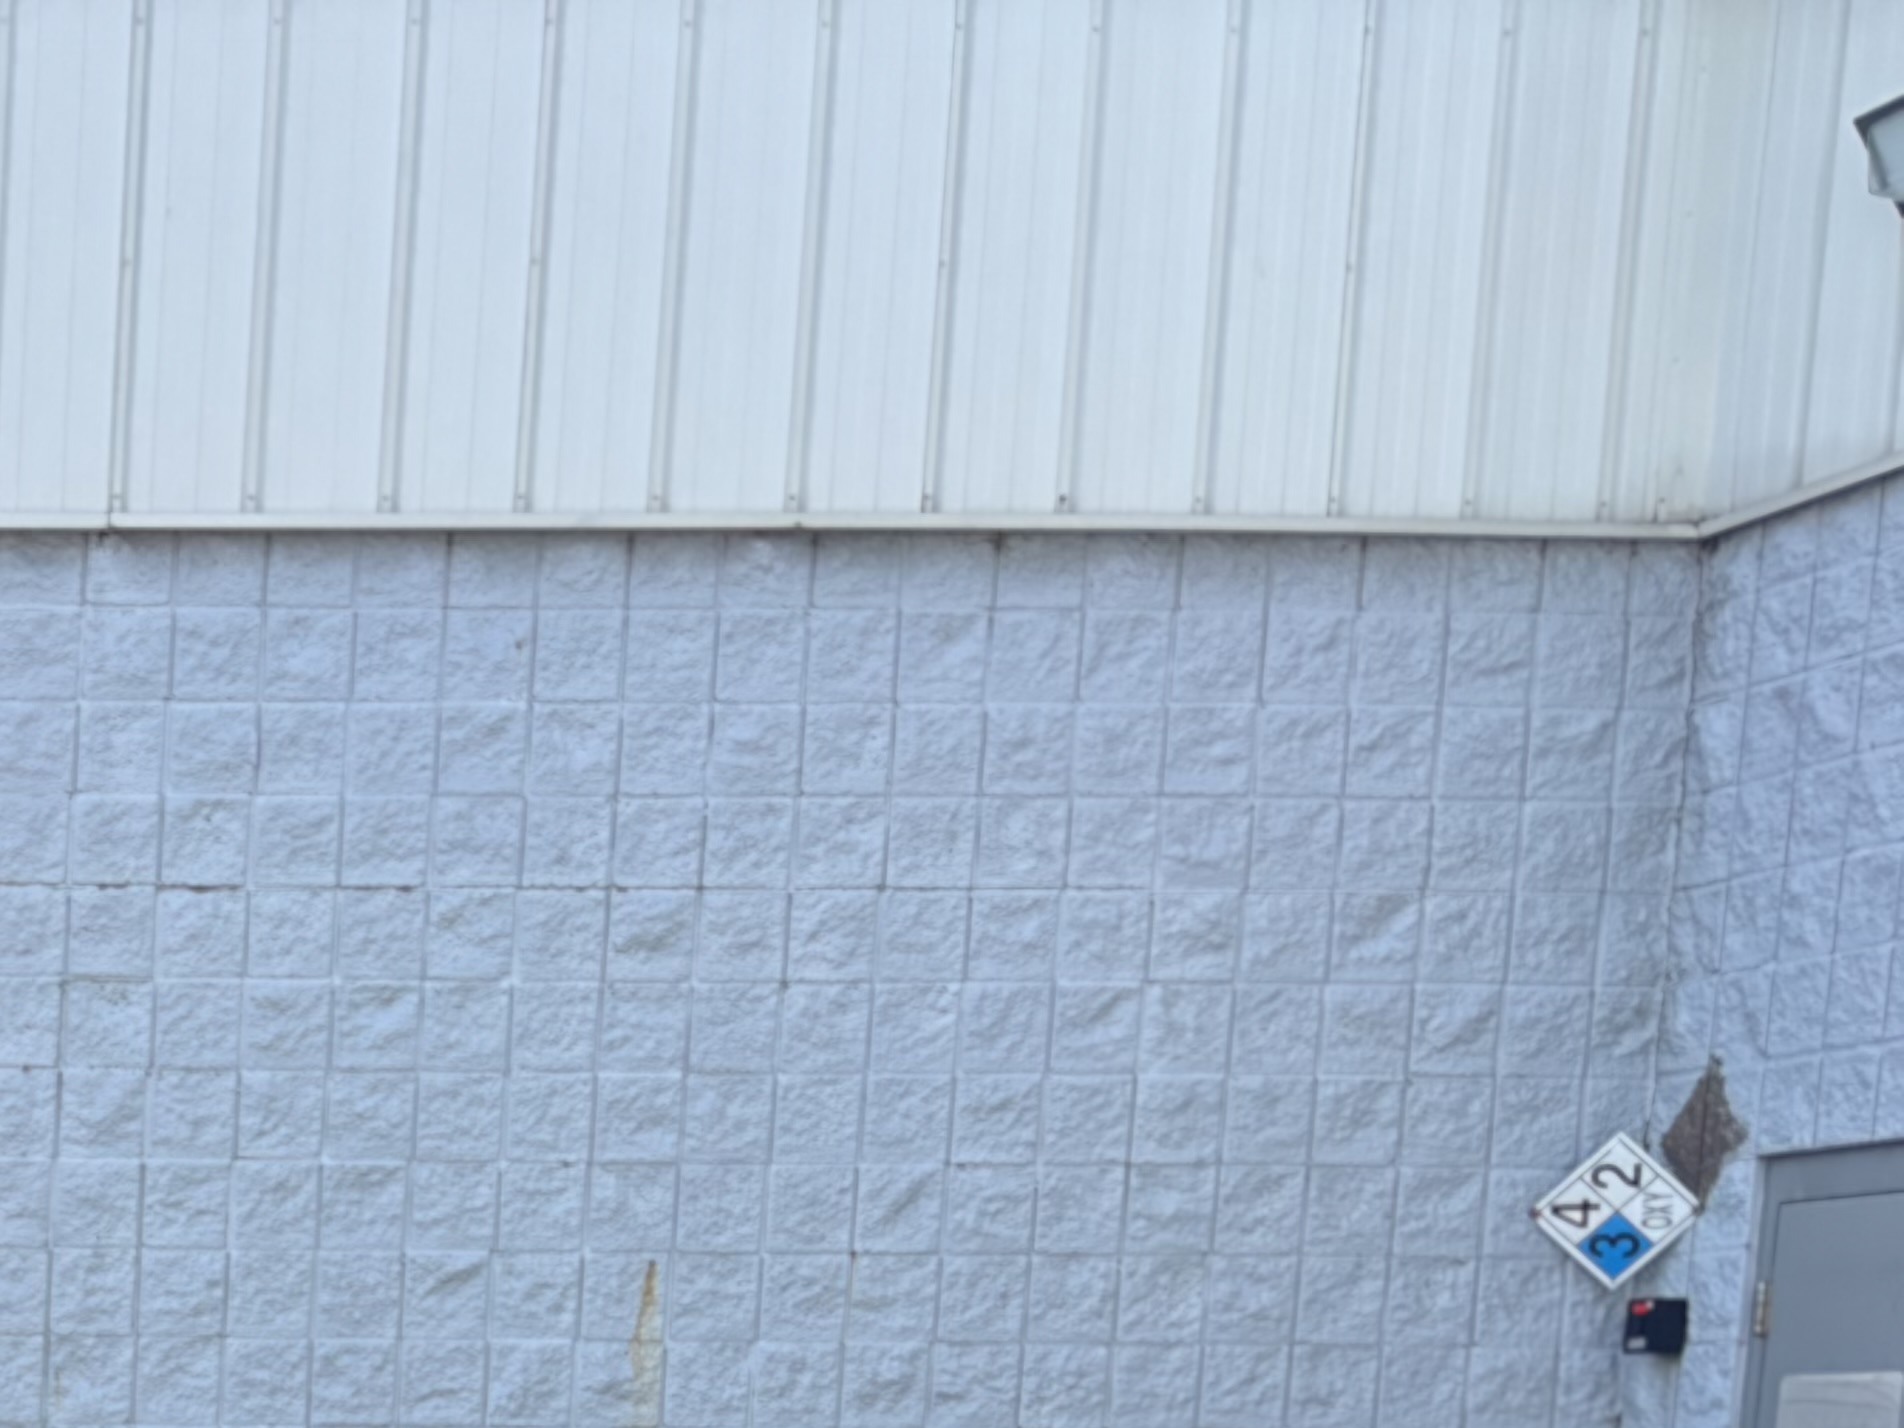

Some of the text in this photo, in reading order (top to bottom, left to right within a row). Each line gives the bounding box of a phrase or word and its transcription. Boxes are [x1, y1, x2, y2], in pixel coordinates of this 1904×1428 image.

[1591, 1162, 1643, 1189] 2
[1551, 1199, 1601, 1229] 4
[1641, 1191, 1674, 1230] OXY
[1588, 1231, 1641, 1259] 3
